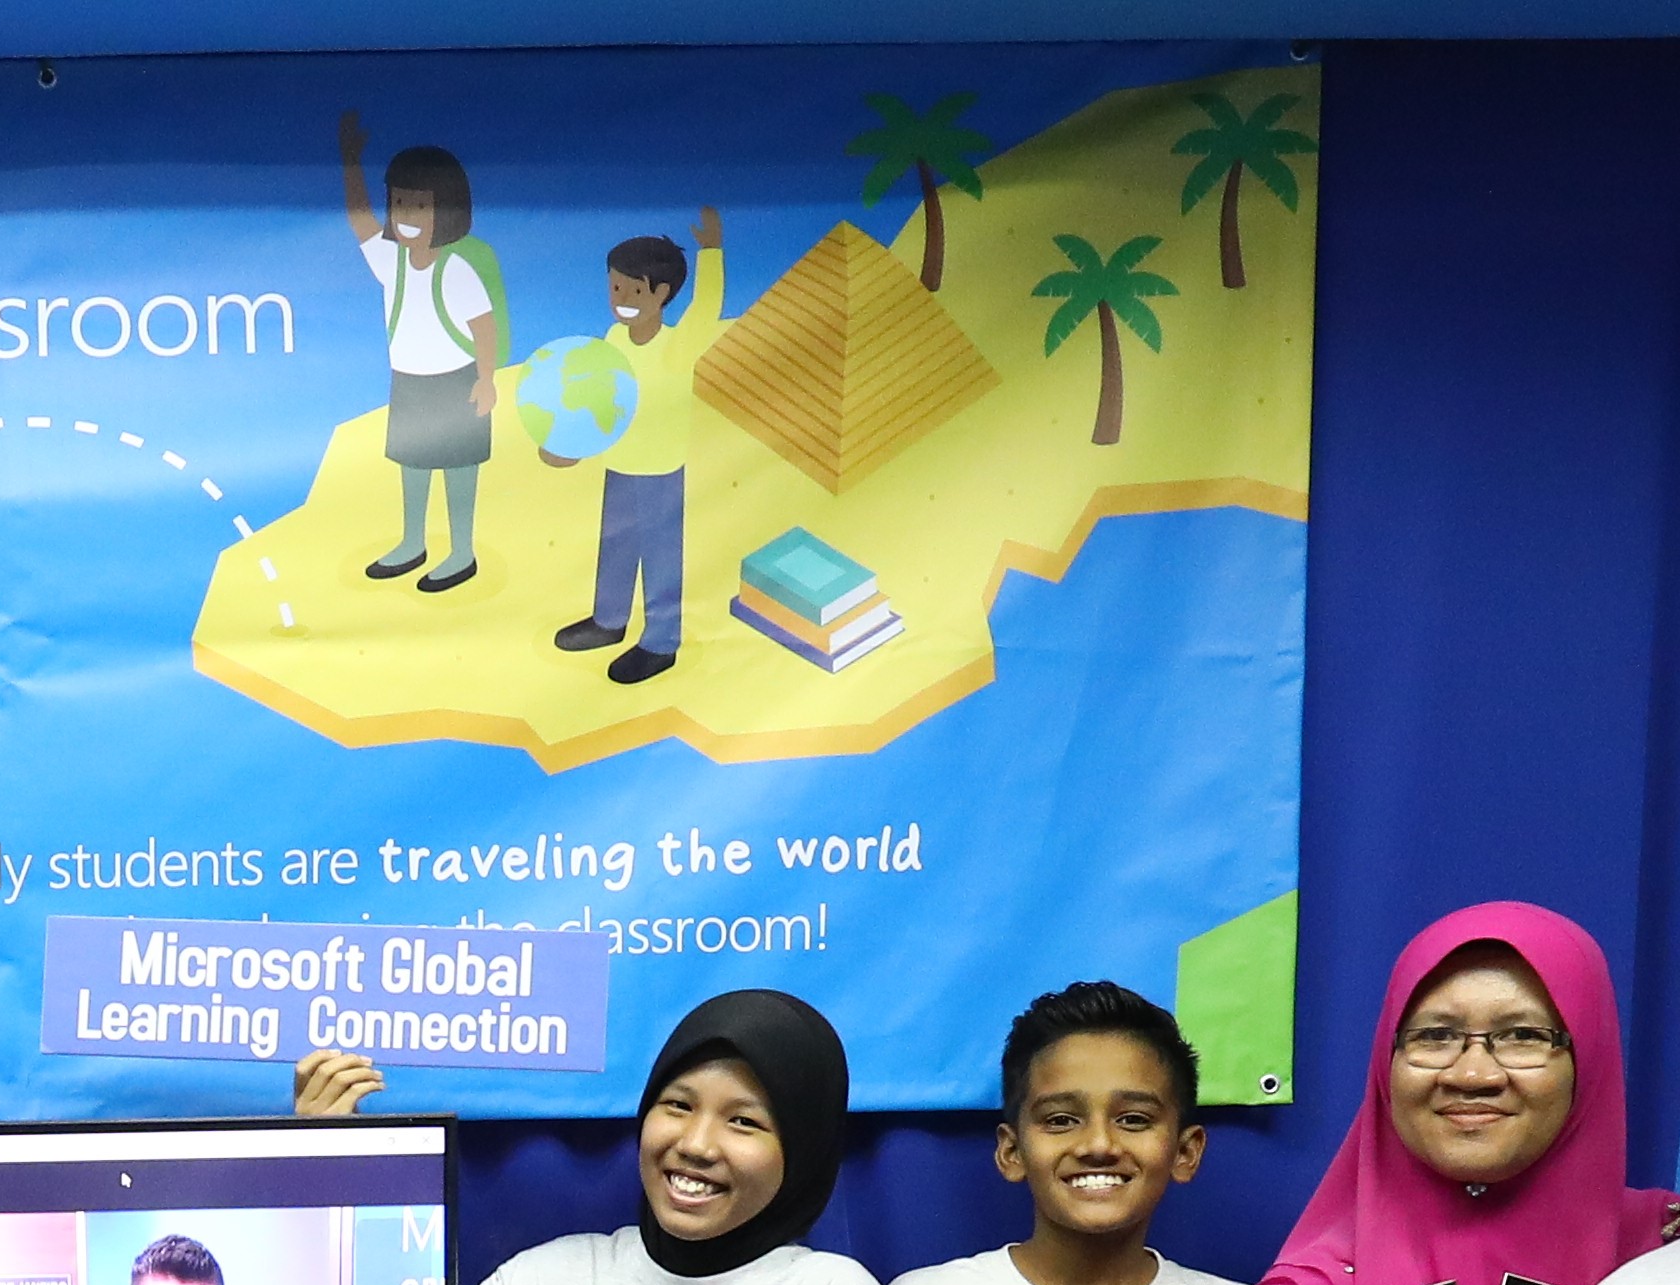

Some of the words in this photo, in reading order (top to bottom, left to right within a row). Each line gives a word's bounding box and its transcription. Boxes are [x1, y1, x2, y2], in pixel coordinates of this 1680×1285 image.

[48, 837, 264, 889] students
[281, 847, 358, 886] are
[378, 832, 636, 891] traveling
[657, 827, 753, 876] the
[776, 822, 923, 873] world
[120, 931, 365, 993] Microsoft
[381, 936, 533, 997] Global
[76, 989, 279, 1058] Learning
[308, 996, 567, 1055] Connection
